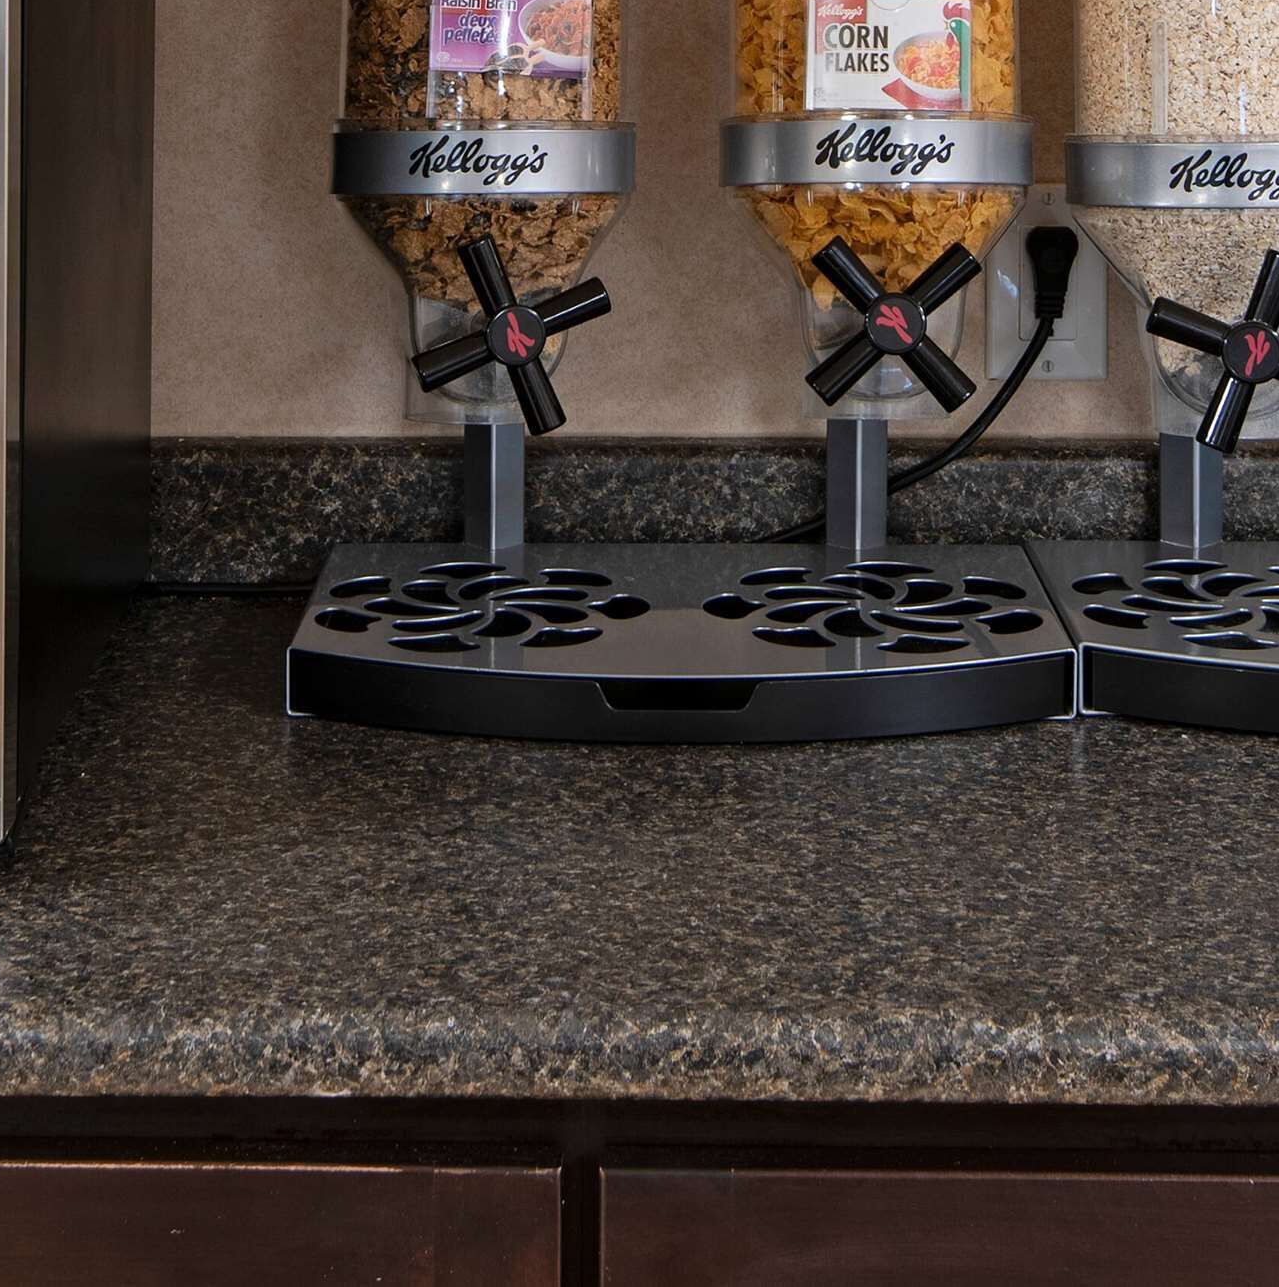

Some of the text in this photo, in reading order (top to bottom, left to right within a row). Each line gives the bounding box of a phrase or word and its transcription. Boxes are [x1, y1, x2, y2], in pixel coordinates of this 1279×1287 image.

[817, 2, 864, 20] Kellogg's
[824, 24, 889, 49] CORN
[824, 52, 890, 73] FLAKES
[409, 134, 548, 185] Kellogg's
[815, 123, 955, 175] Kellogg's
